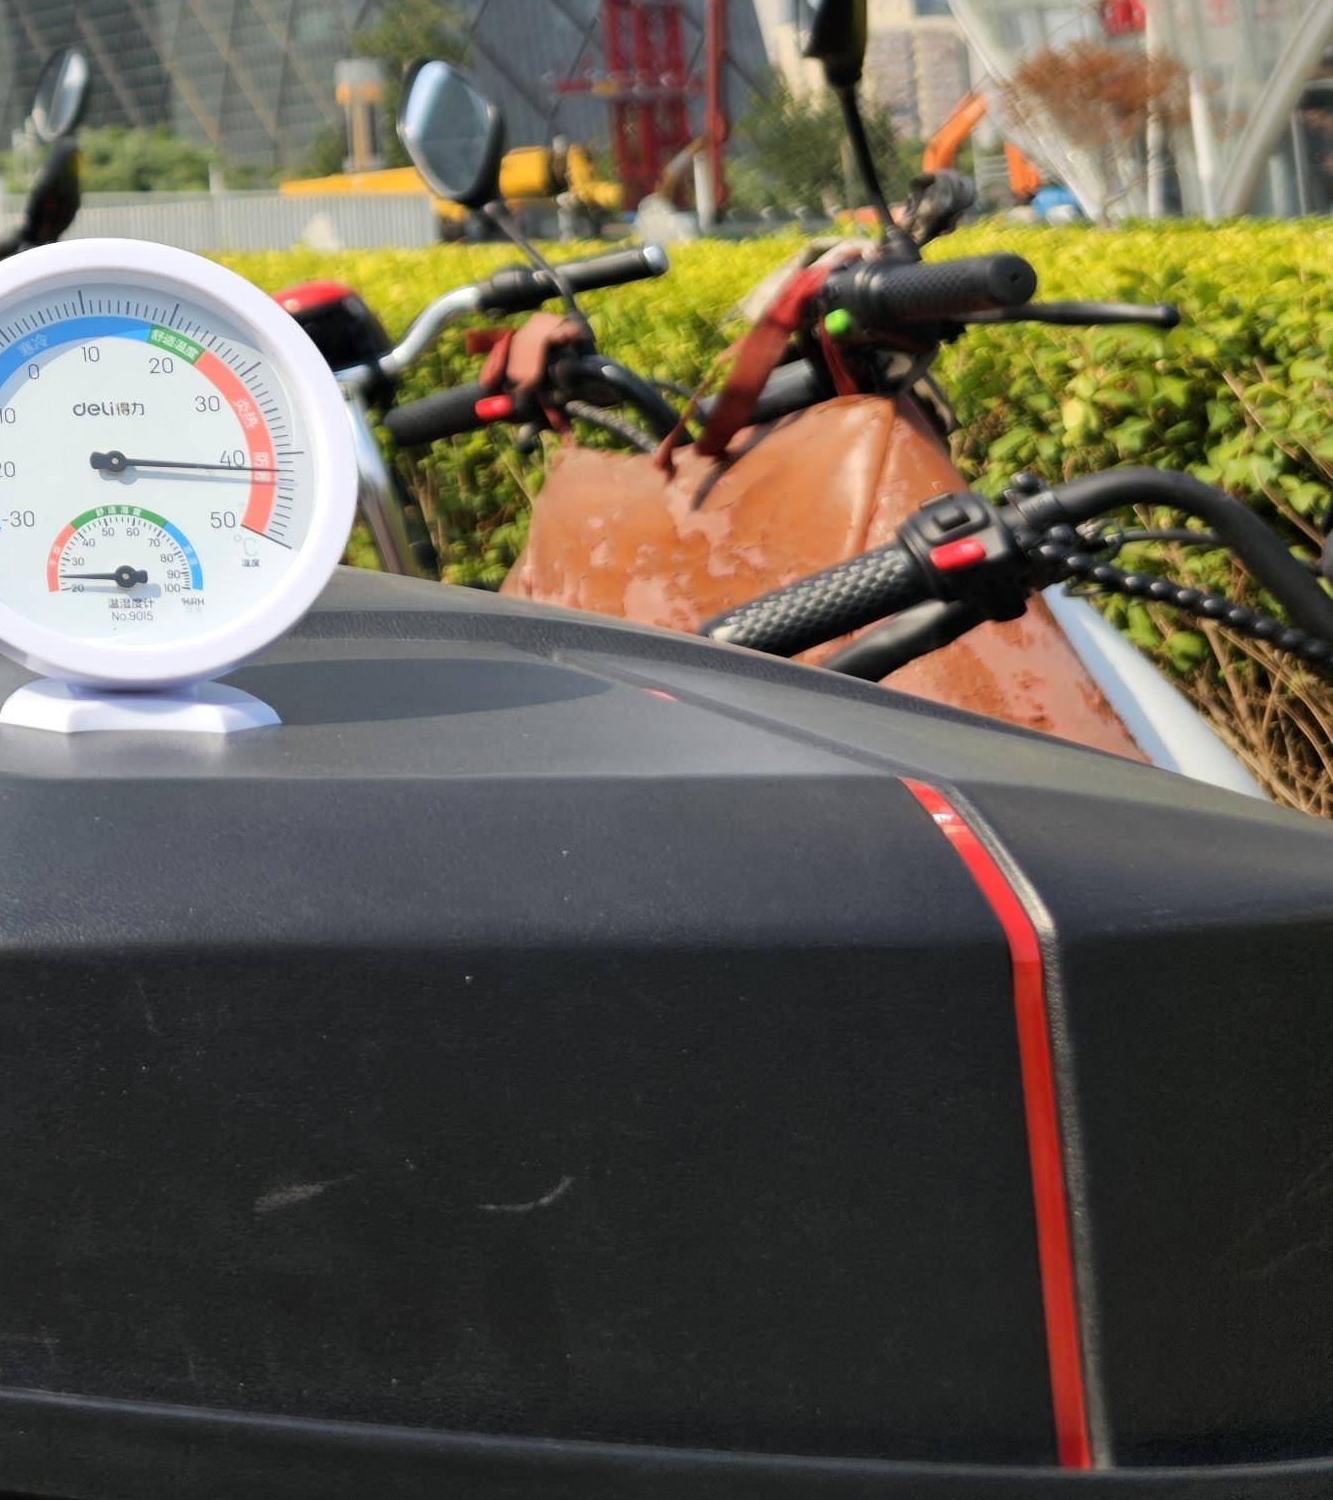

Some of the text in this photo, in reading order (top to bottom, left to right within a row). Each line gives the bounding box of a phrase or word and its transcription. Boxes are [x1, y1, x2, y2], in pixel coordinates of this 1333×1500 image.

[151, 329, 199, 360] 舒适温度
[83, 346, 100, 362] 10
[149, 357, 174, 373] 20
[28, 364, 40, 379] 0
[195, 396, 220, 412] 30
[219, 450, 245, 468] 40
[2, 511, 35, 527] -30
[211, 511, 236, 528] 50
[102, 527, 115, 537] 50
[126, 527, 140, 537] 60
[82, 538, 95, 548] 40
[148, 538, 161, 548] 70
[71, 557, 85, 566] 30
[160, 553, 174, 563] 80
[167, 569, 181, 579] 90
[71, 583, 84, 593] 20
[164, 583, 181, 593] 100
